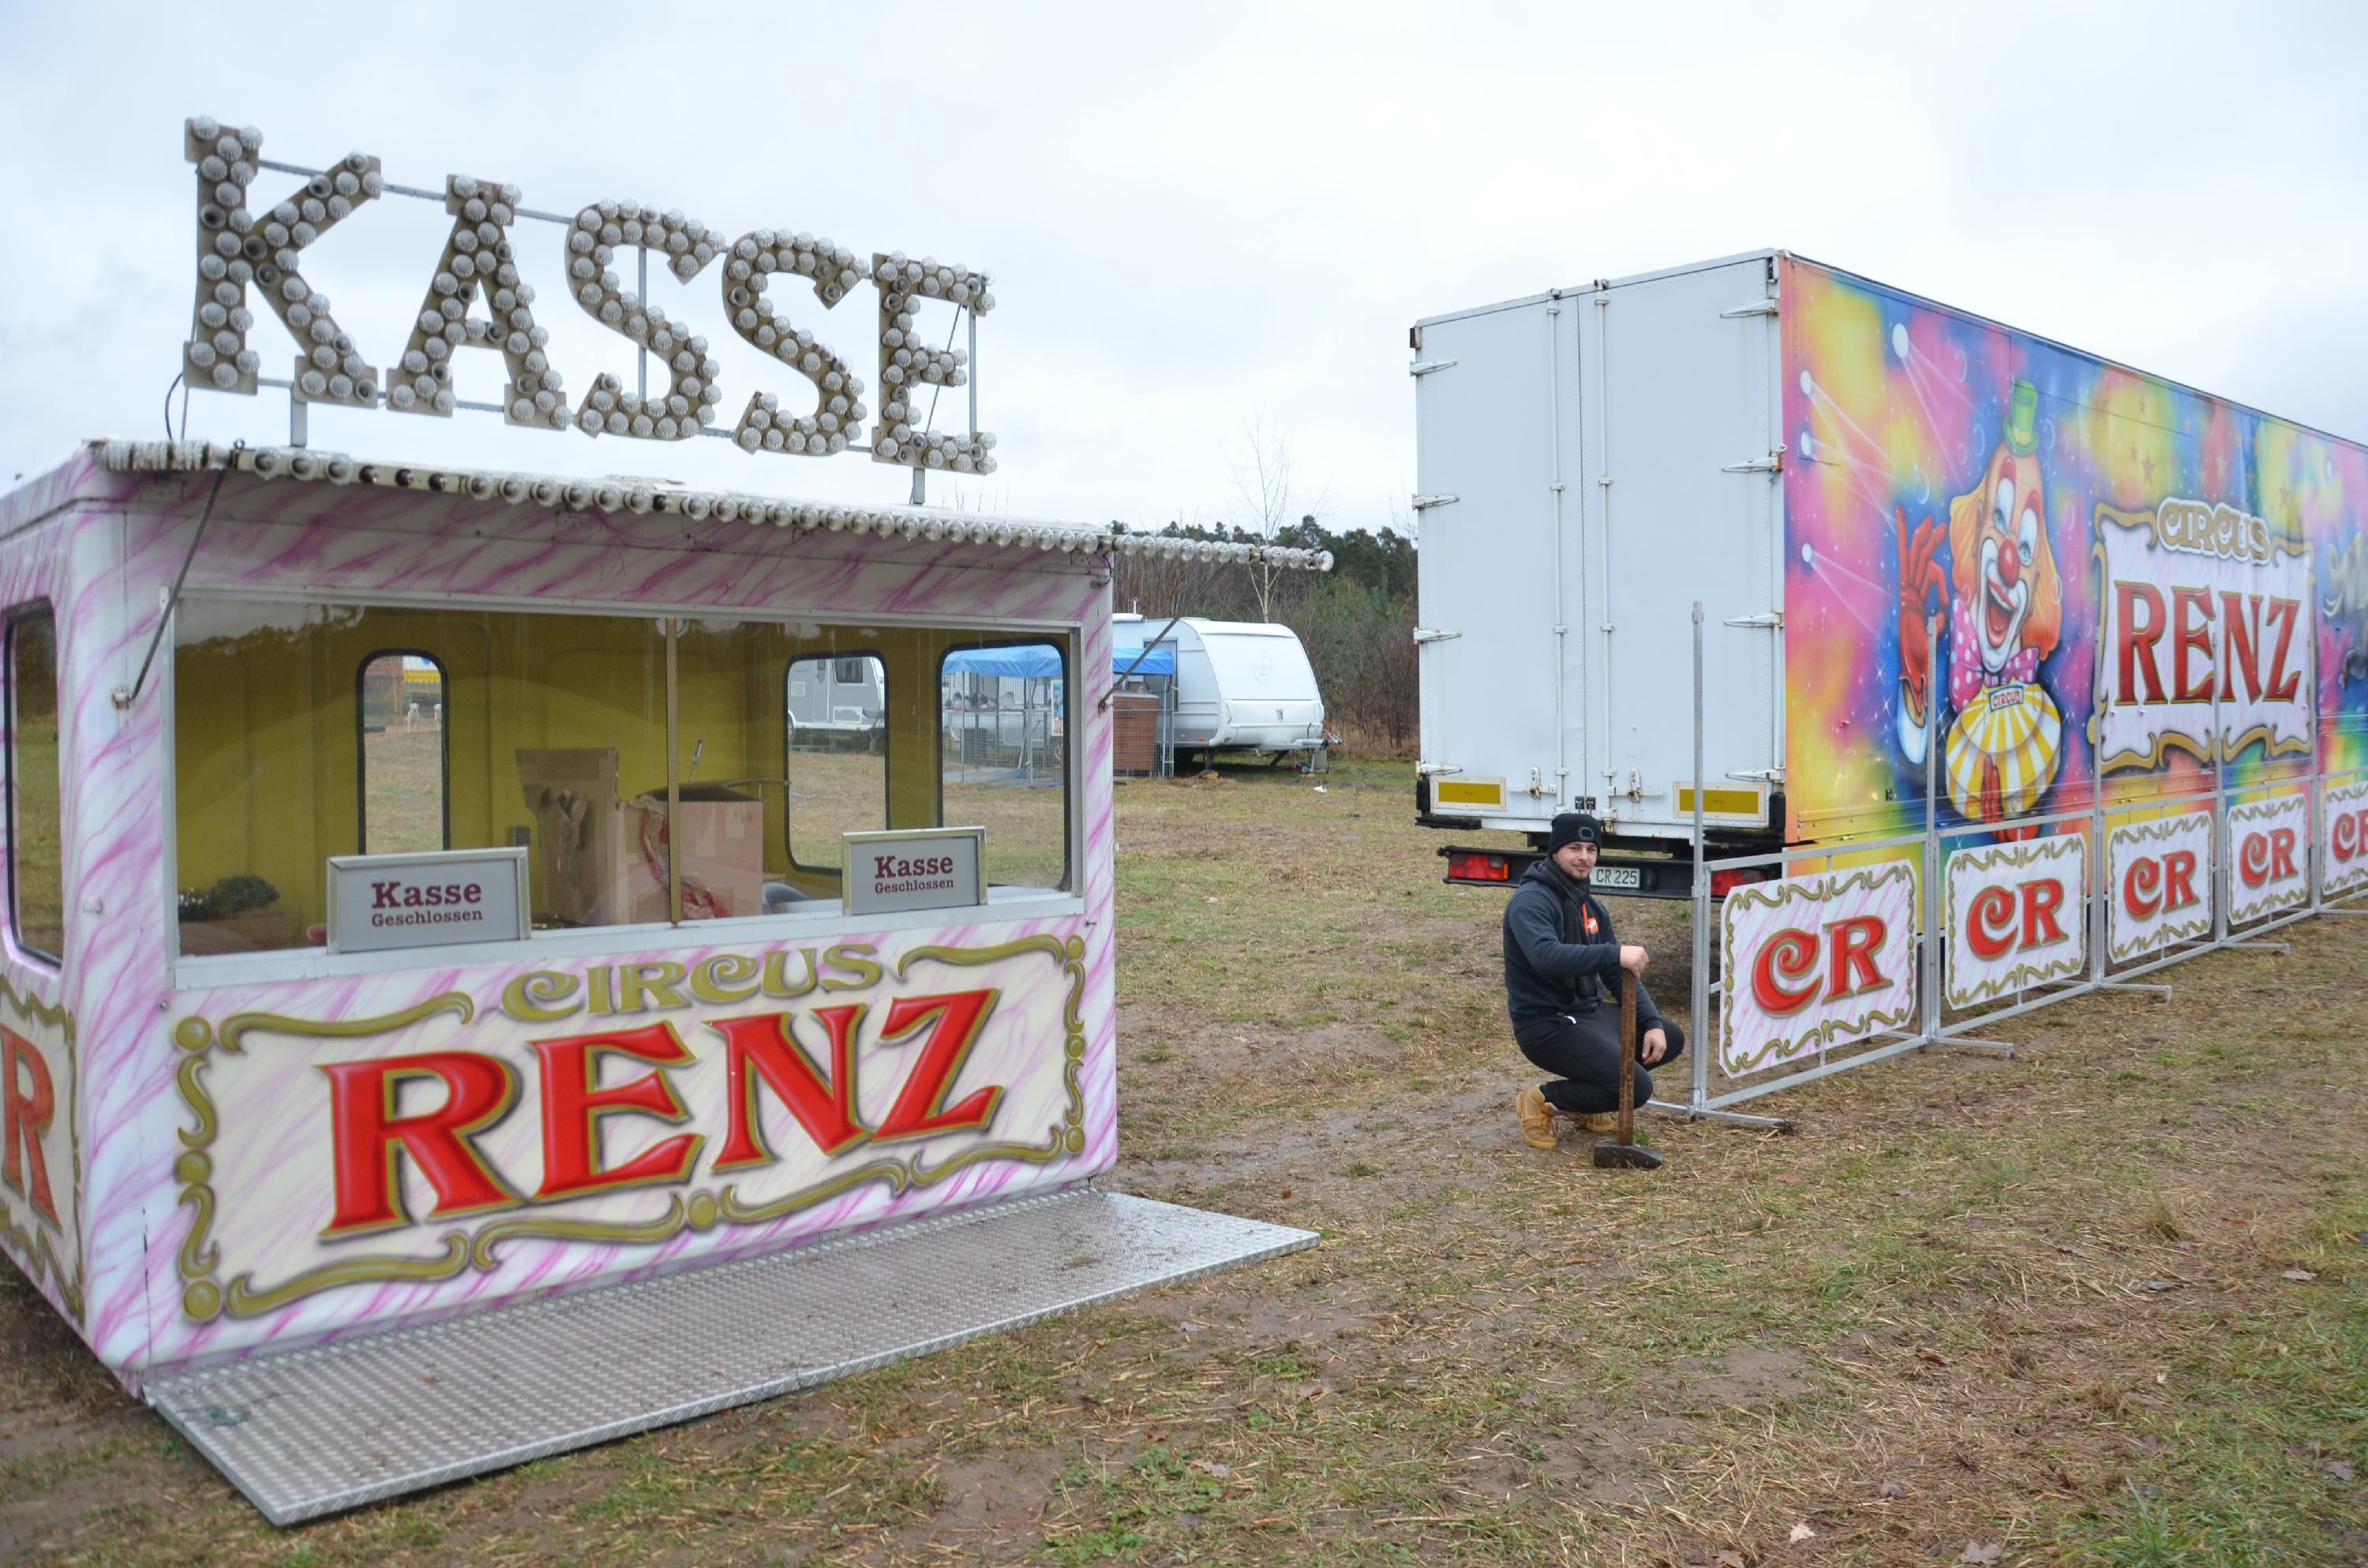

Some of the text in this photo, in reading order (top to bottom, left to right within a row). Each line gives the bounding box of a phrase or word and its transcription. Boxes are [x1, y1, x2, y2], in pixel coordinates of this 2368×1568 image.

[184, 117, 998, 475] KASSE
[2159, 501, 2270, 562] CIRCUS
[2113, 580, 2301, 706] RENZ
[1993, 690, 2021, 708] CIRCUS
[874, 855, 954, 878] Kasse
[874, 879, 954, 894] Geschlossen
[1597, 869, 1637, 885] CR 225
[2123, 850, 2199, 920] CR
[2239, 827, 2299, 889] CR
[371, 881, 482, 909] Kasse
[371, 908, 483, 927] Geschlossen
[1965, 878, 2069, 960] CR
[500, 944, 883, 1020] CIRCUS
[1751, 915, 1894, 1016] CR
[315, 988, 1002, 1240] RENZ
